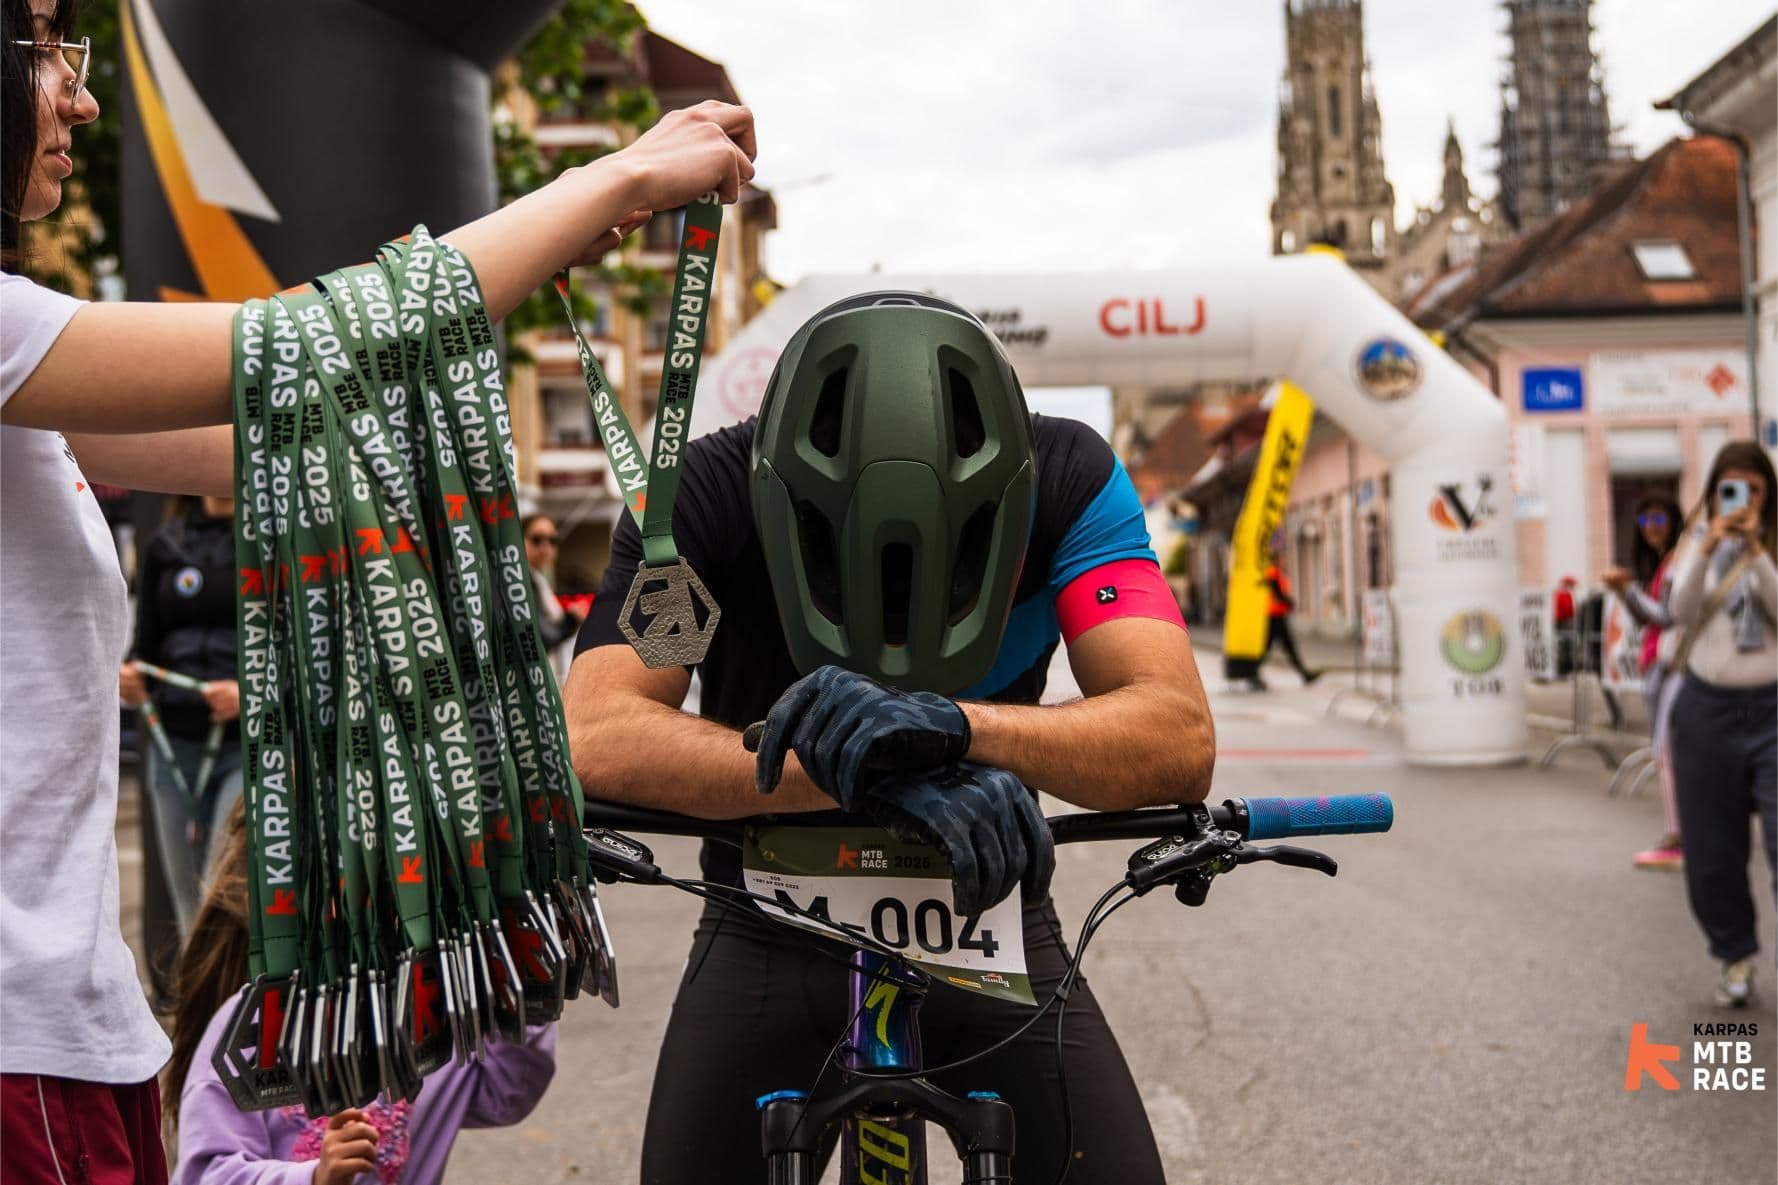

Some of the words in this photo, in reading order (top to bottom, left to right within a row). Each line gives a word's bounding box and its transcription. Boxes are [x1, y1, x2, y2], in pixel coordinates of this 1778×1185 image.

[355, 272, 399, 340] 2025
[474, 306, 493, 345] RACE
[670, 254, 711, 369] KARPAS
[1099, 295, 1206, 339] CILJ
[297, 304, 352, 375] 2025
[438, 327, 457, 359] MTB
[449, 318, 469, 356] RACE
[466, 315, 485, 347] MTB
[376, 351, 393, 383] MTB
[388, 341, 405, 381] RACE
[333, 383, 357, 416] MTB
[343, 371, 371, 411] RACE
[664, 371, 679, 406] RACE
[677, 372, 694, 400] MTB
[271, 412, 283, 452] RACE
[282, 412, 296, 445] MTB
[309, 403, 324, 435] MTB
[448, 361, 494, 493] KARPAS
[656, 407, 686, 470] 2025
[594, 391, 649, 493] KARPAS
[271, 455, 292, 536] 2025
[303, 445, 335, 526] 2025
[452, 524, 490, 662] KARPAS
[500, 544, 532, 622] 2025
[365, 558, 414, 697] KARPAS
[402, 577, 445, 659] 2025
[243, 600, 268, 739] KARPAS
[305, 586, 336, 728] KARPAS
[434, 656, 457, 698] RACE
[423, 666, 443, 701] MTB
[263, 712, 273, 745] MTB
[350, 726, 363, 766] RACE
[359, 725, 372, 758] MTB
[464, 678, 505, 814] KARPAS
[380, 712, 417, 853] KARPAS
[433, 699, 481, 838] KARPAS
[262, 749, 294, 886] KARPAS
[355, 769, 377, 851] 2025
[861, 850, 883, 860] MTB
[861, 859, 888, 869] RACE
[895, 855, 930, 870] 2025
